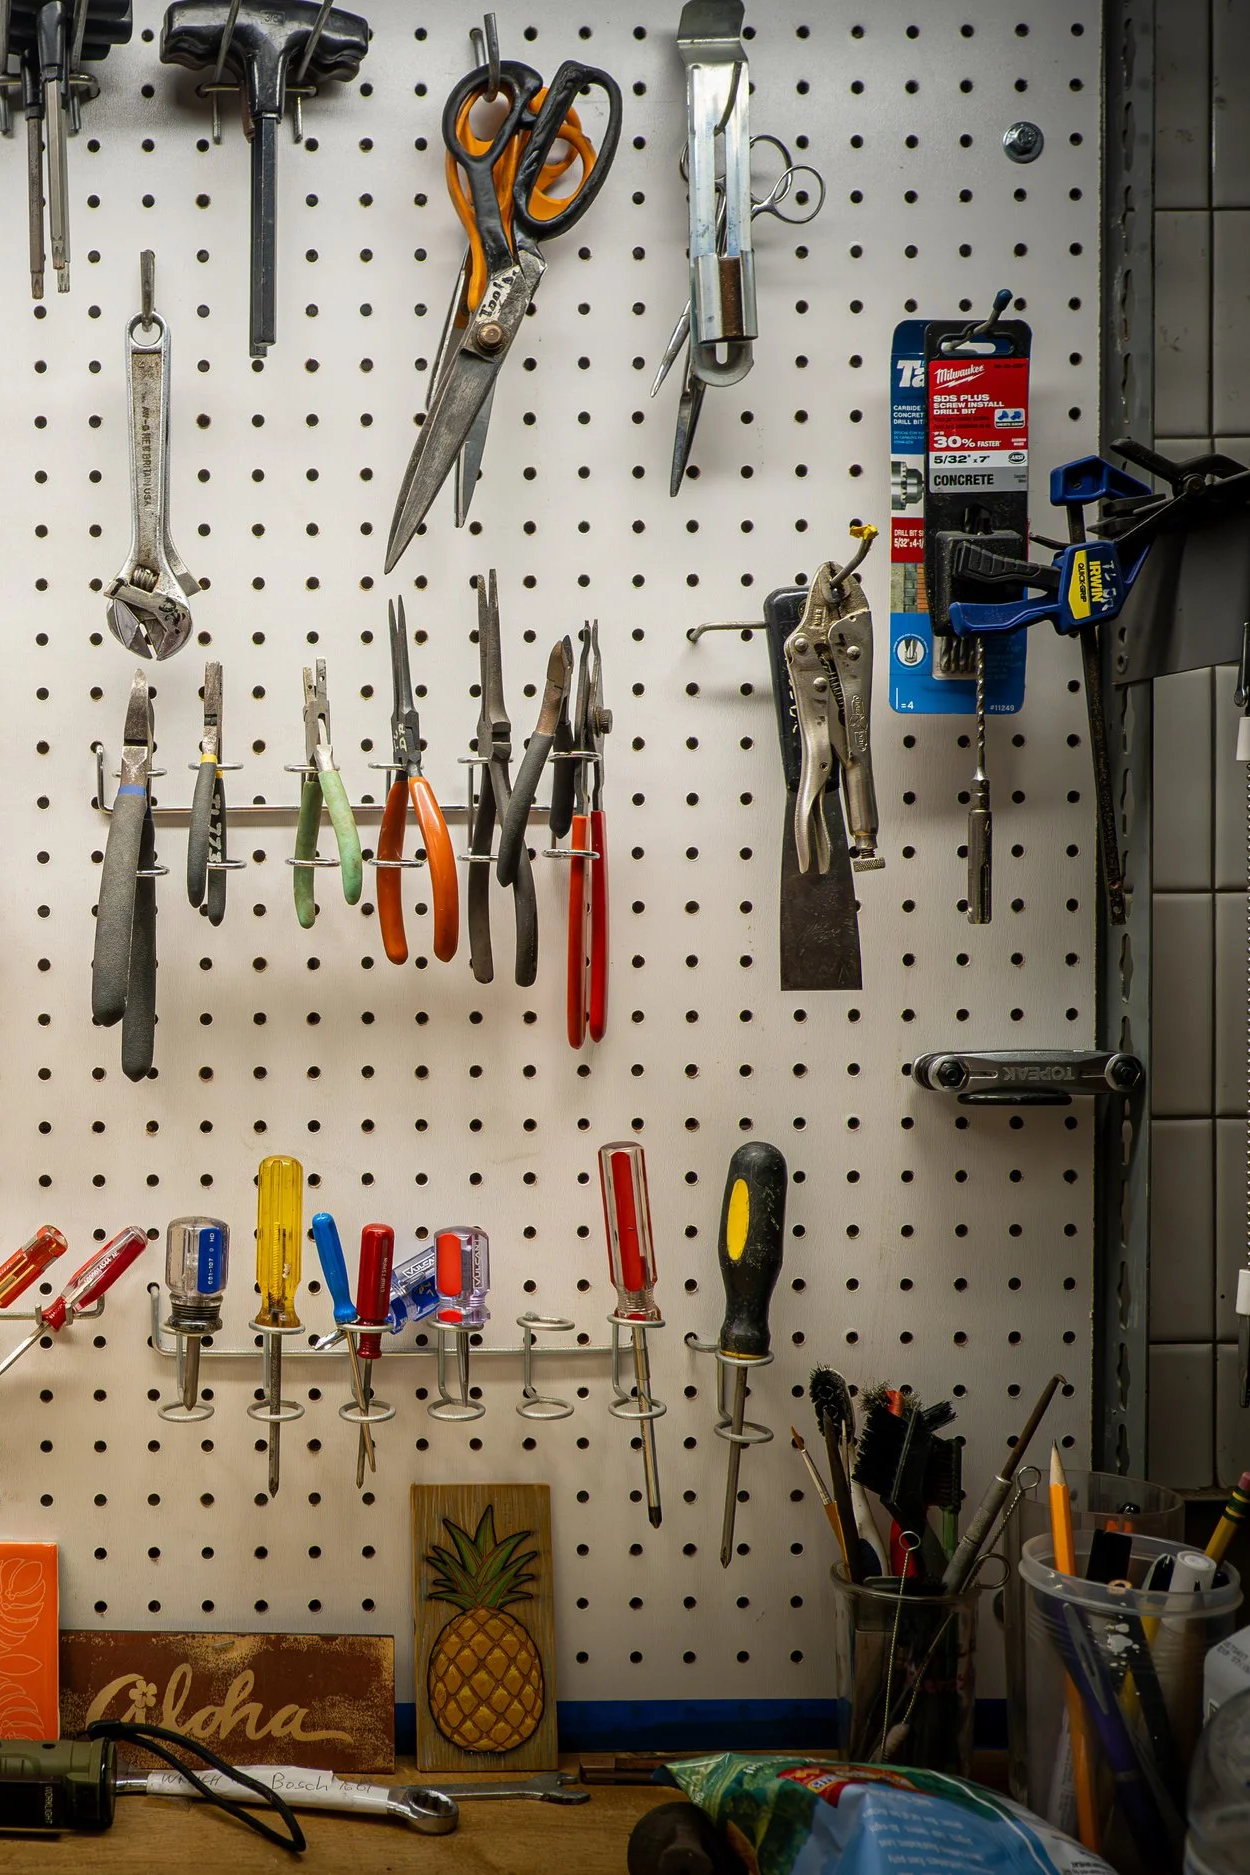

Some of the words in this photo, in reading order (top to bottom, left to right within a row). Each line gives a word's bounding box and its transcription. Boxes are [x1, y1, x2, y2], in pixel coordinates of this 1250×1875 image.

[934, 364, 984, 384] Milwaukee
[960, 394, 989, 402] PLUS
[933, 436, 975, 449] 30%
[934, 455, 971, 464] 5/32"
[933, 474, 994, 487] CONCRETE
[143, 487, 152, 506] USA
[912, 538, 924, 548] 4-1/
[1089, 560, 1103, 602] IRWIN
[1002, 1066, 1075, 1081] TOPEAK
[473, 1240, 482, 1288] VULCAN
[271, 1771, 328, 1791] Bosch
[44, 1785, 54, 1825] WORKLIGHT
